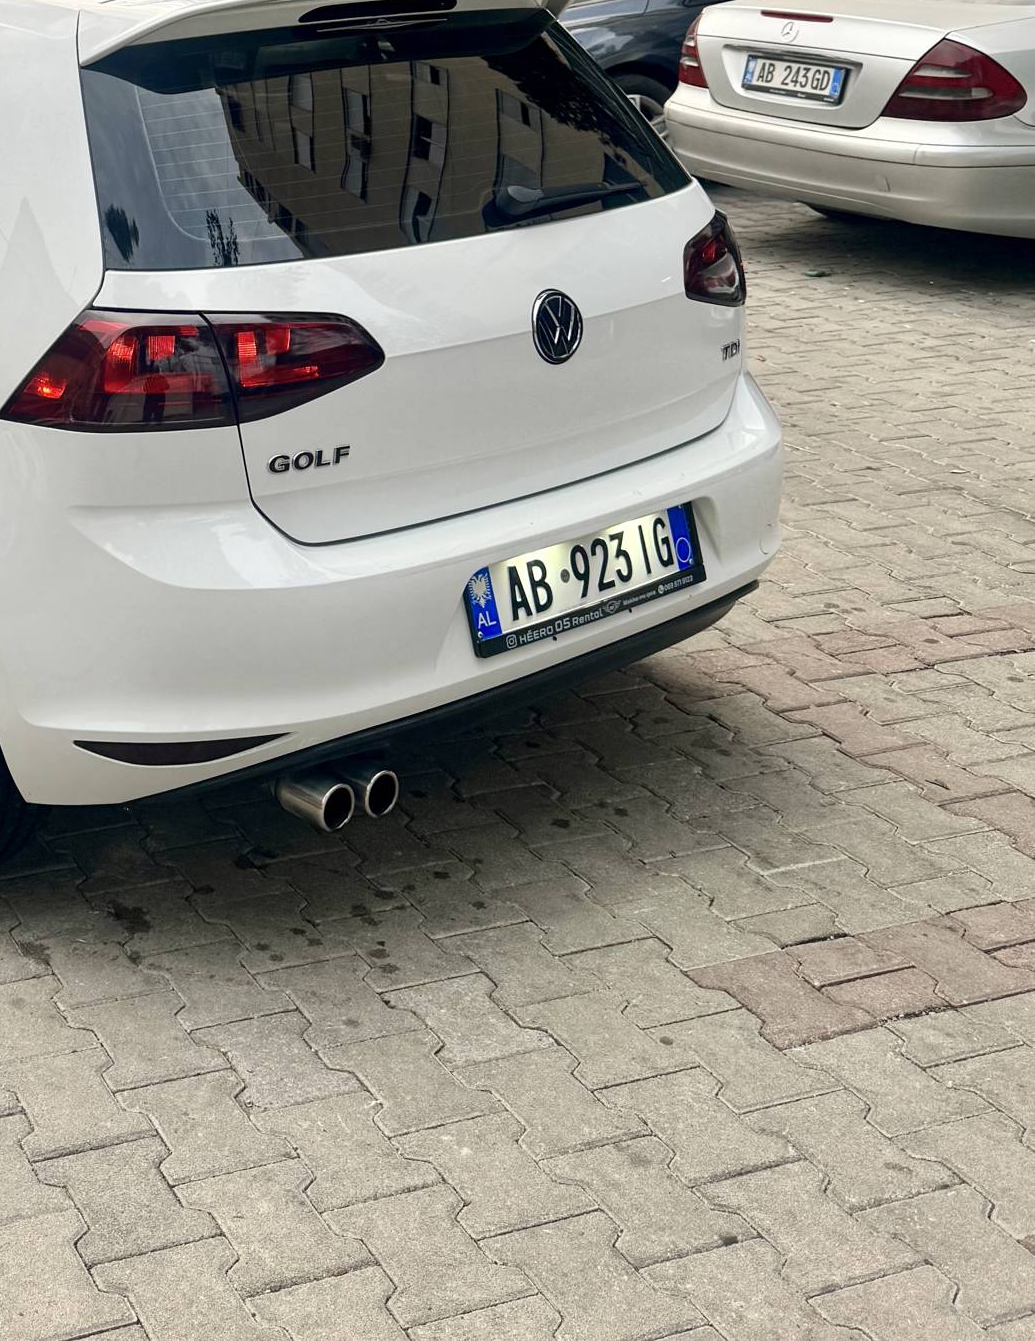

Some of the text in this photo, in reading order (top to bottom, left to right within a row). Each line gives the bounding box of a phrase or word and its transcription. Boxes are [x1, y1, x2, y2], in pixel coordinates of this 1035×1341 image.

[756, 62, 831, 91] AB 243 GD
[267, 445, 351, 474] GOLF
[507, 517, 675, 621] AB 923 IG
[477, 610, 497, 629] AL
[519, 625, 554, 644] HÉERO
[572, 608, 604, 627] Rental
